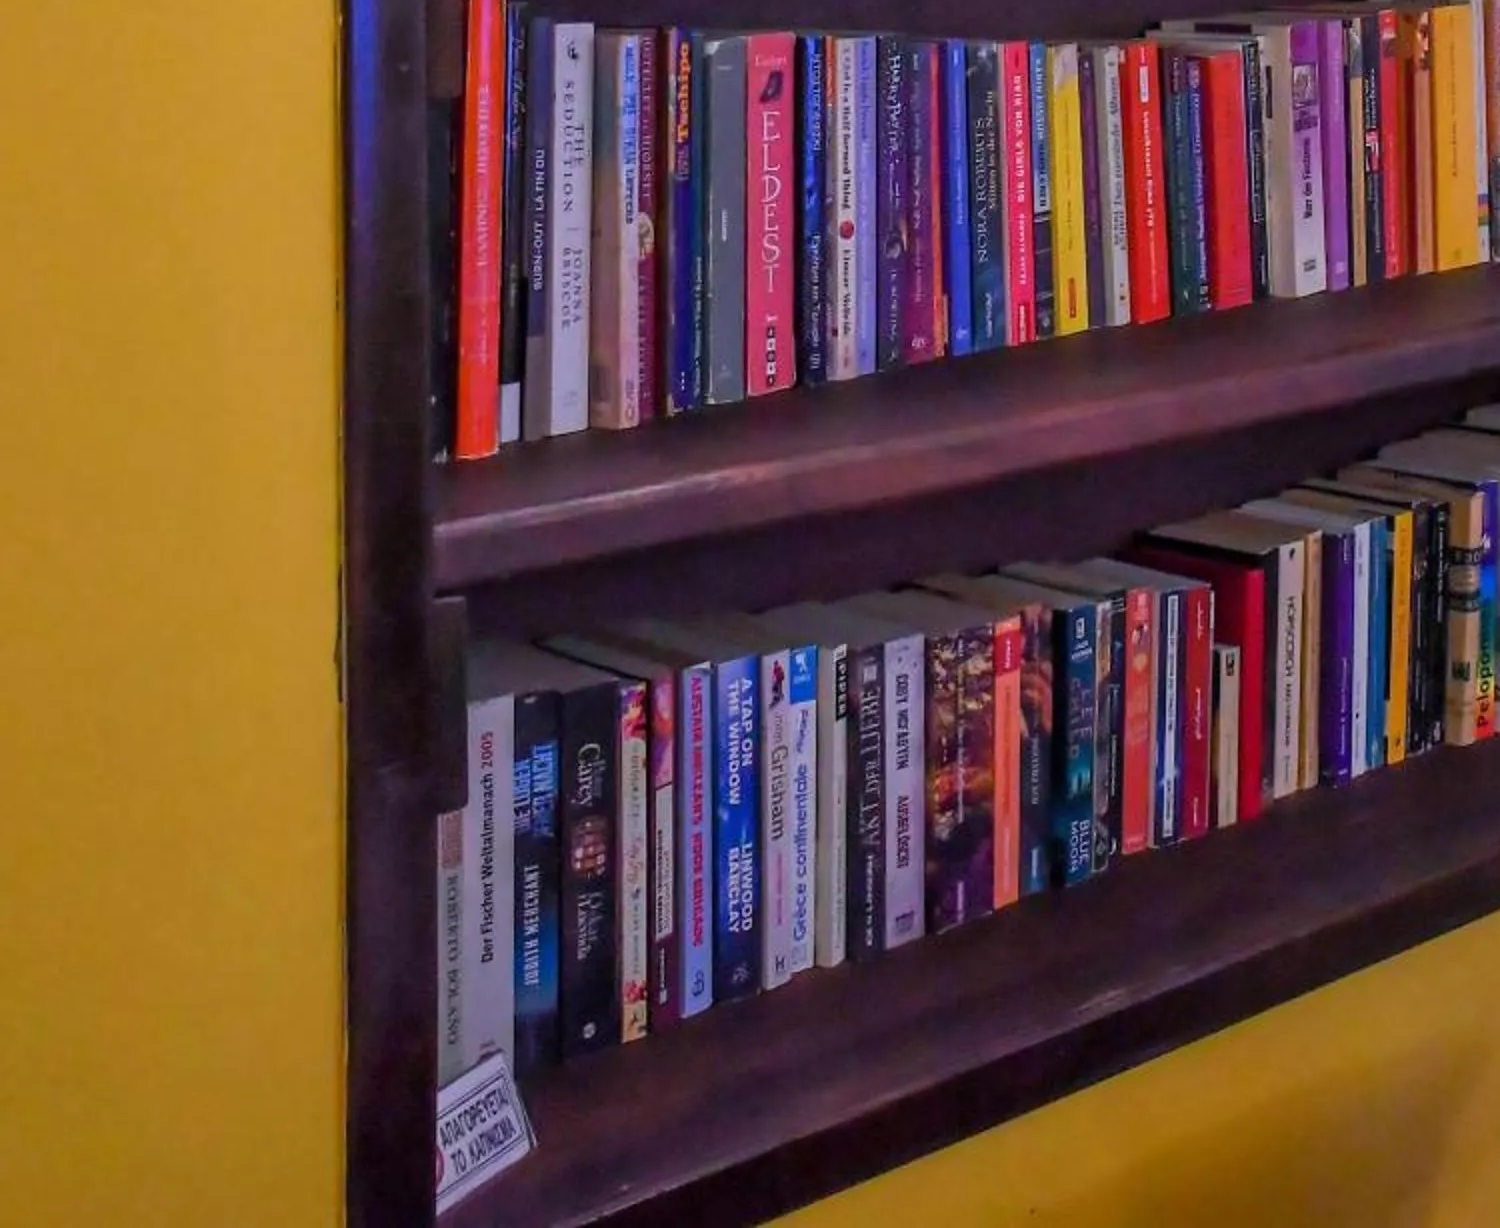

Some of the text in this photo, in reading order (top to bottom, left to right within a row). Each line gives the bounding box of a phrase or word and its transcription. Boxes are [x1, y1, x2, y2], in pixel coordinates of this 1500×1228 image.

[677, 41, 691, 144] Tschipo
[1015, 111, 1023, 138] VON
[562, 79, 575, 213] SEDUCTION
[574, 122, 586, 166] THE
[1015, 139, 1025, 177] GIRLS
[761, 110, 782, 293] ELDEST
[974, 117, 988, 263] NORA ROBERTS
[1016, 181, 1025, 203] DIE
[561, 246, 573, 331] BRISCOE
[572, 248, 583, 324] JOANNA
[728, 679, 741, 805] THE WINDOW
[740, 690, 752, 735] TAP
[740, 738, 752, 766] ON
[770, 745, 788, 841] Grisham
[480, 731, 494, 963] Der Fischer Weltalmanach 2005
[793, 763, 808, 941] Grèce continentale
[1069, 820, 1080, 873] MOON
[1079, 818, 1090, 865] BLUE
[523, 863, 540, 987] JUDITH MERCHANT
[728, 846, 741, 933] BARCLAY
[741, 841, 753, 931] LINWOOD
